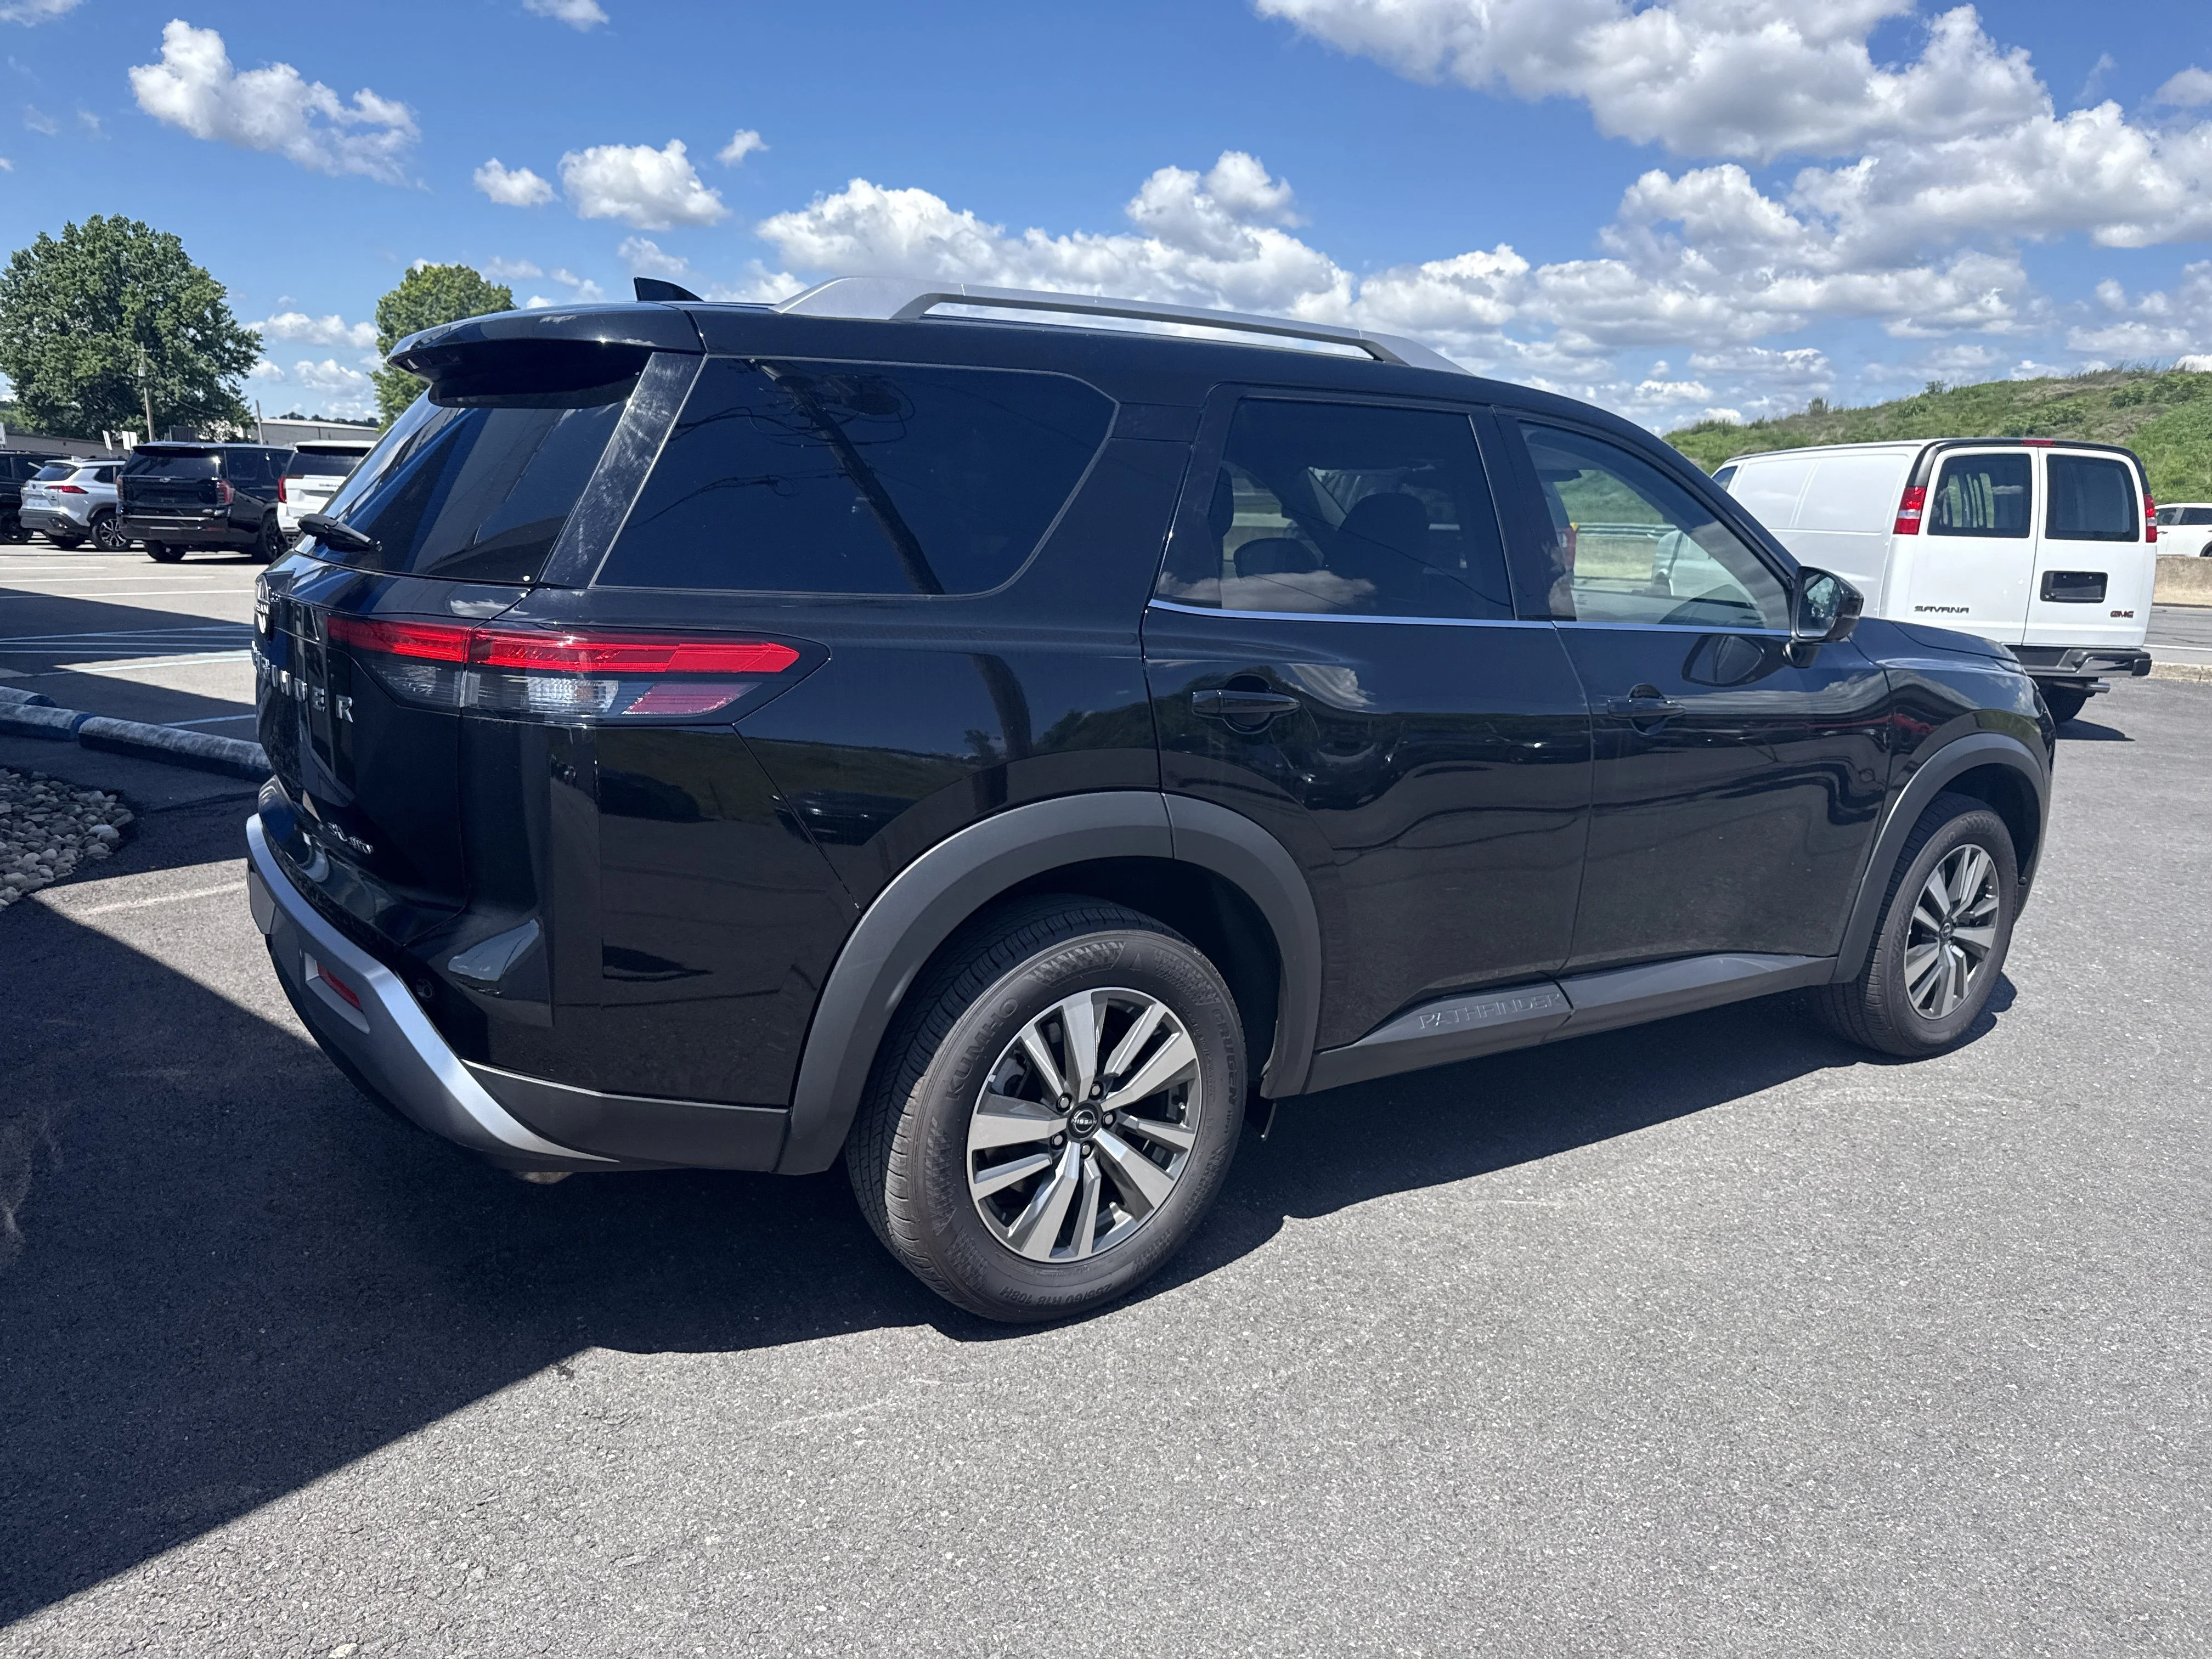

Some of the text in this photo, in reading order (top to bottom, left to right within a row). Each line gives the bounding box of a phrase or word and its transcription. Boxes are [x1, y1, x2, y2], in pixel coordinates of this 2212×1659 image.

[1914, 606, 1969, 614] SAVANA
[2111, 610, 2134, 618] GMC
[1418, 992, 1563, 1030] PATHFINDER
[945, 997, 1018, 1101] KUMHO
[1211, 1008, 1238, 1107] CRUGEN
[999, 1283, 1113, 1306] 255/60 R18 108H
